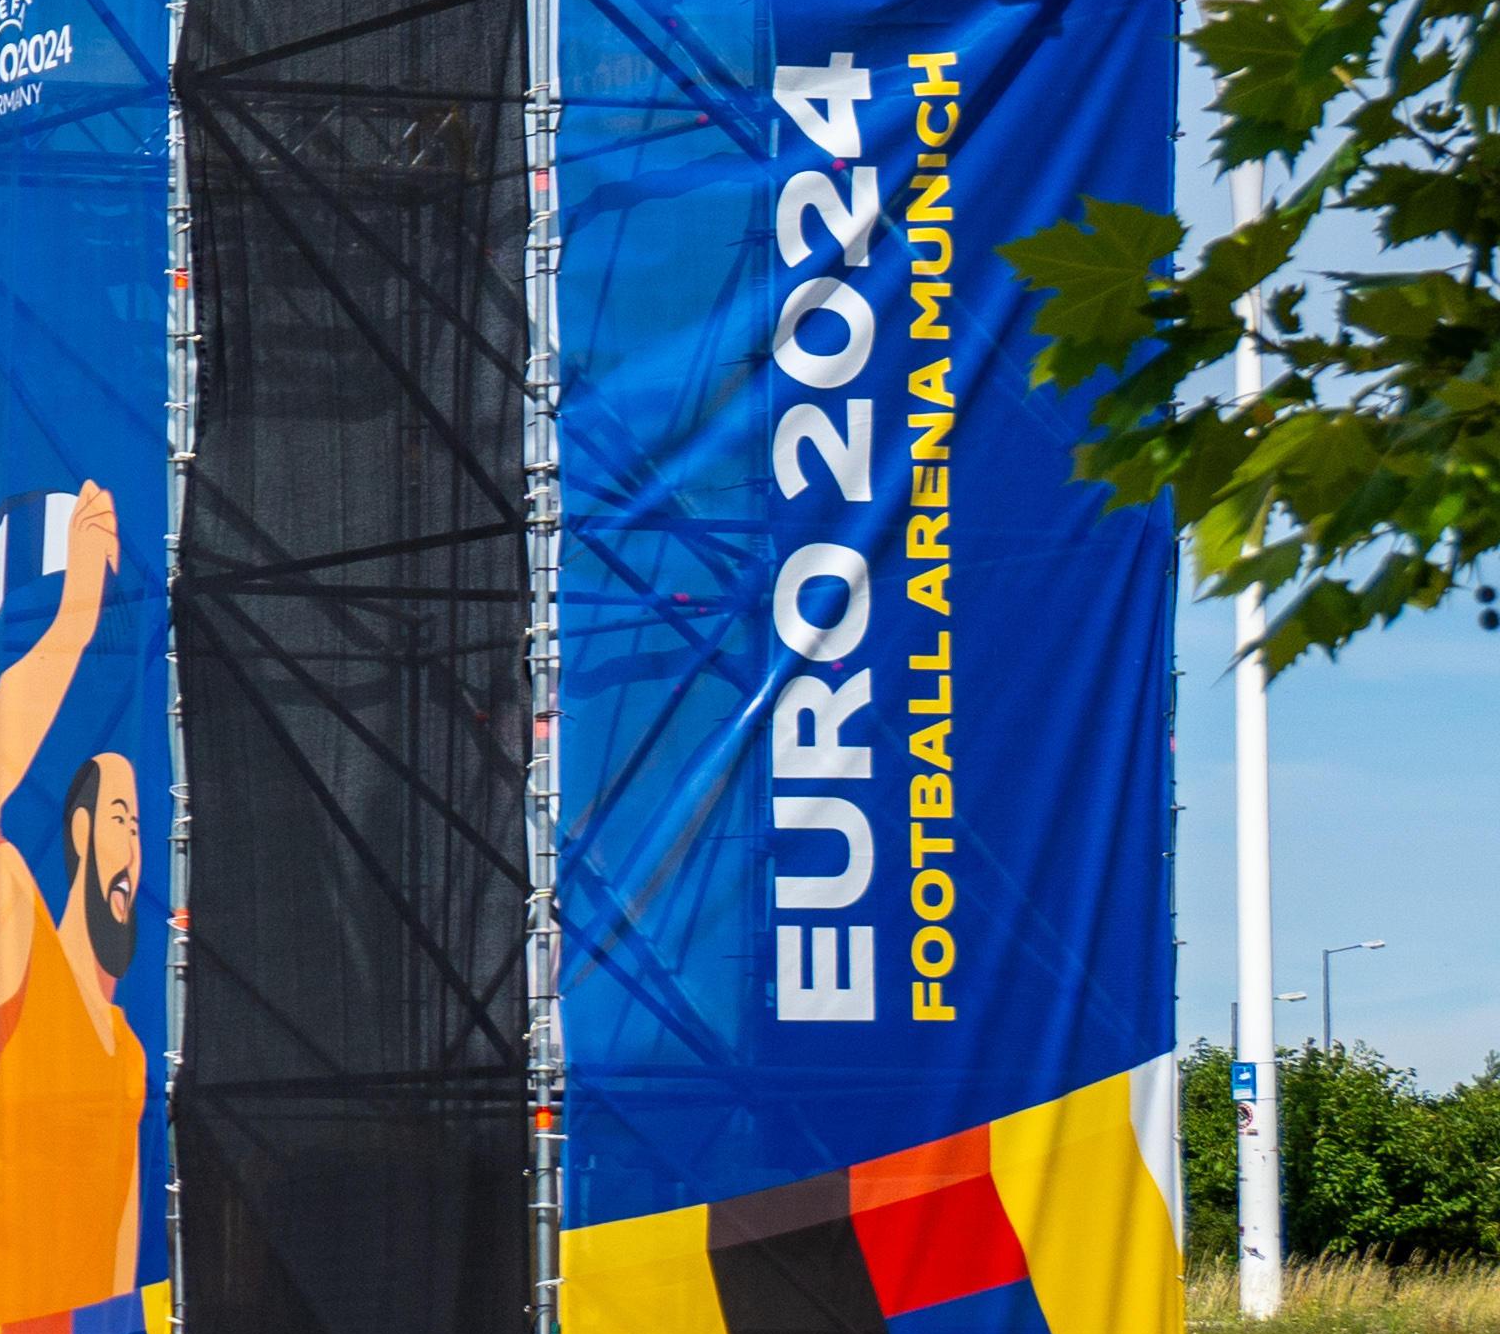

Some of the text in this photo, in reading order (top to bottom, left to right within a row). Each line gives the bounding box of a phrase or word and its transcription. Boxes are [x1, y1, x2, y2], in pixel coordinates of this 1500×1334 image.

[772, 52, 880, 1021] EURO 2024
[906, 53, 960, 1021] FOOTBALL ARENA MUNICH
